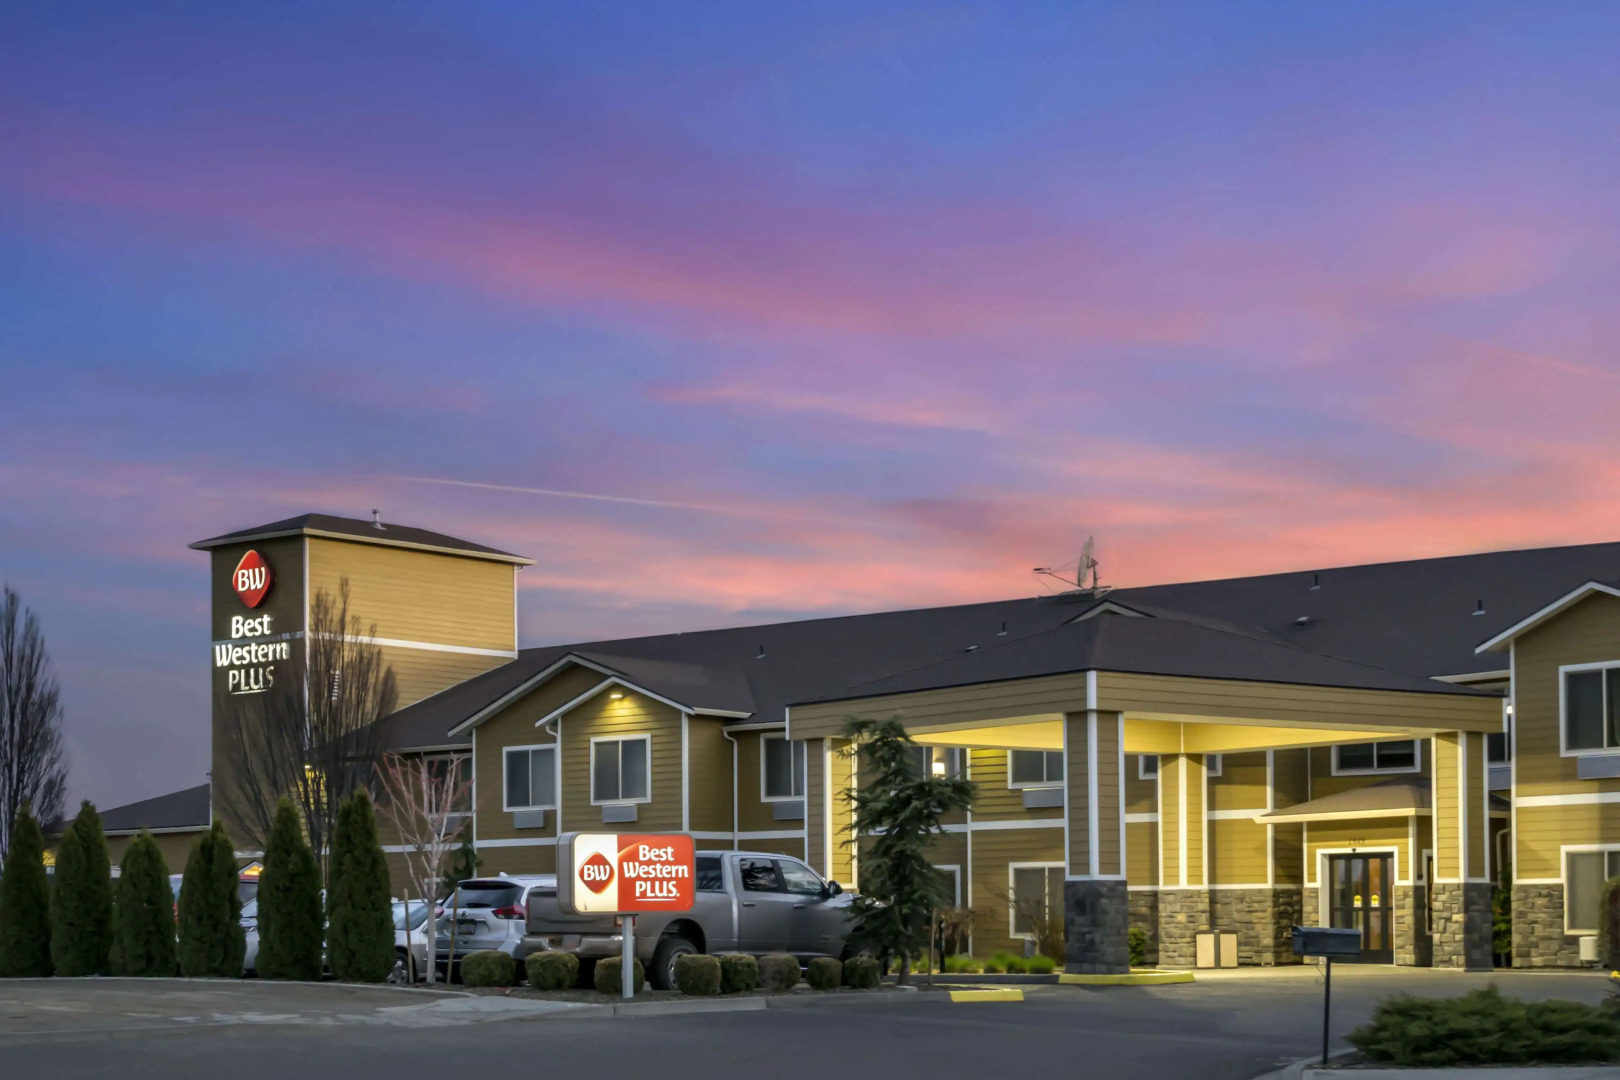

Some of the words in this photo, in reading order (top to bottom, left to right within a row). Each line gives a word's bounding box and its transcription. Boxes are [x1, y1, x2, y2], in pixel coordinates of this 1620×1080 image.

[237, 567, 265, 591] BW
[231, 614, 272, 638] Best
[215, 642, 289, 667] Western
[228, 666, 275, 692] PLUS
[639, 845, 674, 861] Best
[583, 864, 611, 881] BW
[623, 862, 689, 878] Western
